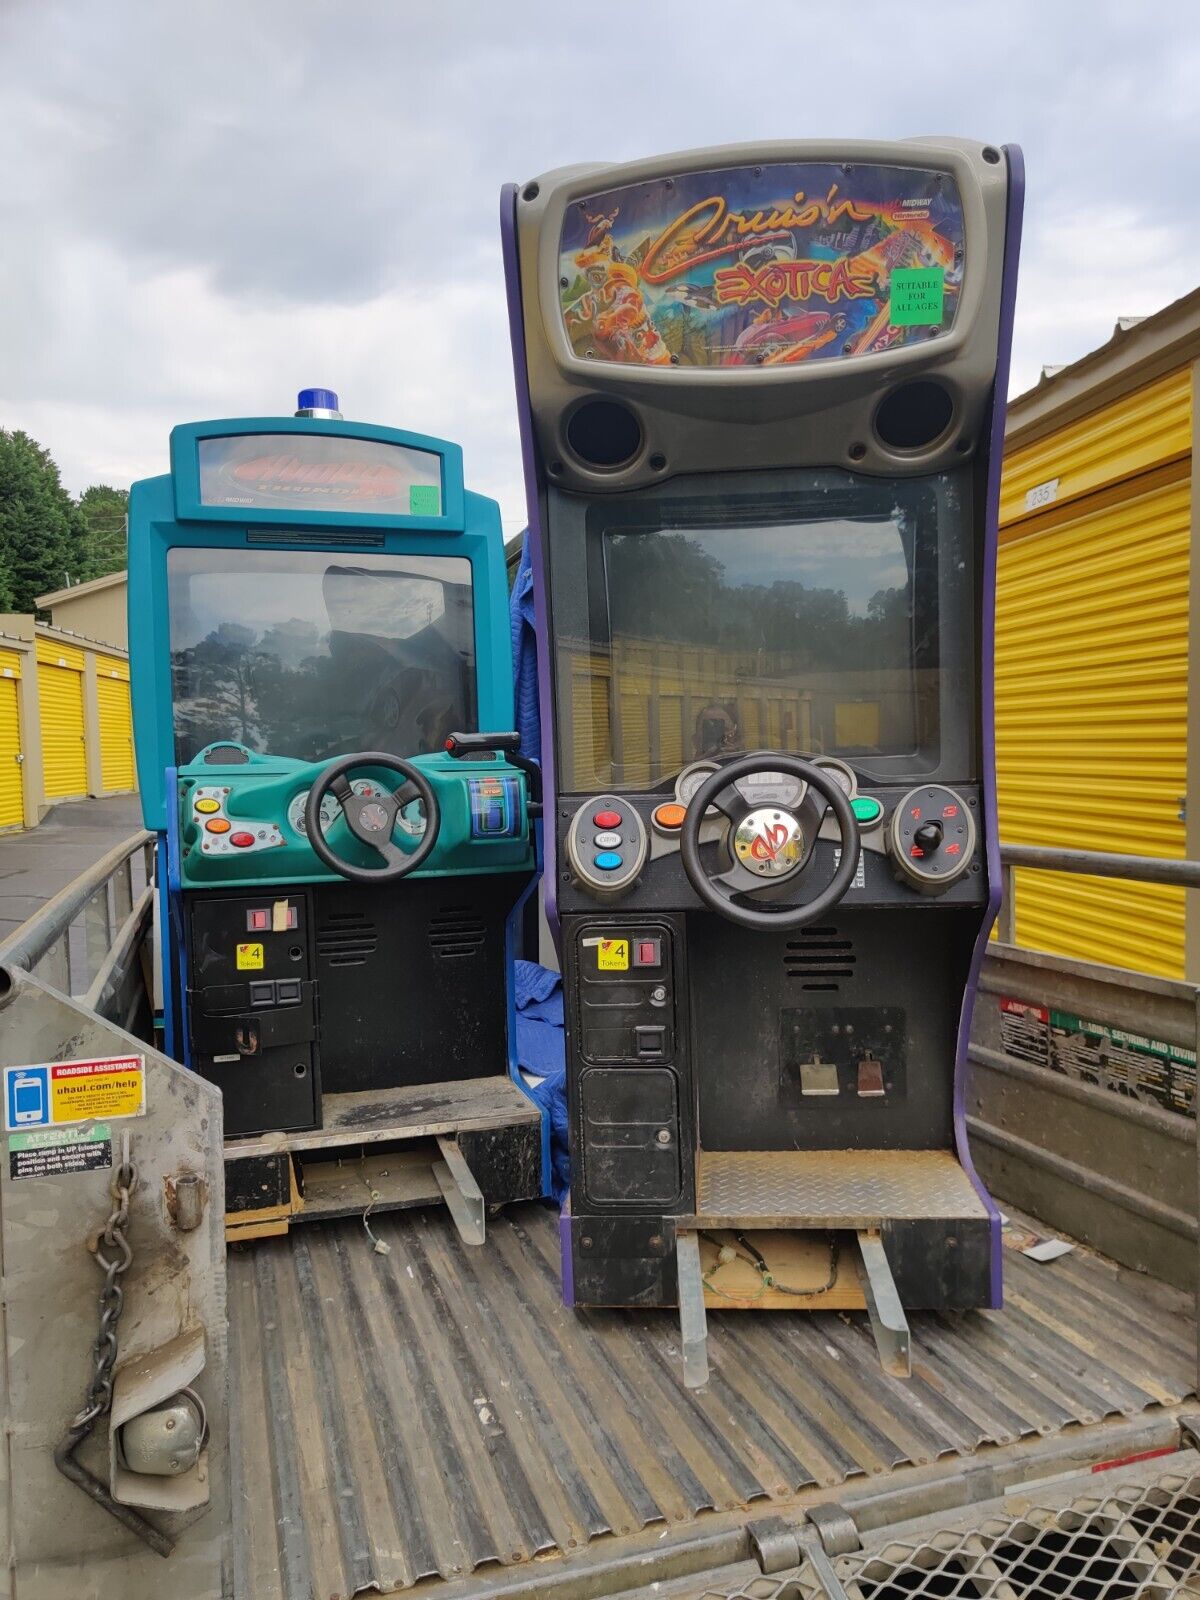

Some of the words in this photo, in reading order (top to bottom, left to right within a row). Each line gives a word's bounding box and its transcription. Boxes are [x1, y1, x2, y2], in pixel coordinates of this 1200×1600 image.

[901, 198, 932, 207] MIDWAY
[639, 184, 873, 285] Cruis'n
[715, 258, 875, 305] EXOTICA
[896, 281, 938, 290] SUITABLE
[896, 303, 913, 311] ALL
[915, 302, 938, 311] AGES
[1032, 485, 1050, 506] 235
[251, 947, 261, 960] 4
[615, 944, 625, 958] 4
[57, 1066, 92, 1076] ROADSIDE
[94, 1062, 137, 1073] ASSISTANCE
[57, 1079, 137, 1095] uhaul.com/help
[66, 1145, 77, 1153] UP
[17, 1157, 46, 1167] position
[47, 1155, 60, 1163] and
[61, 1153, 86, 1161] secure
[87, 1150, 102, 1158] with
[47, 1162, 63, 1170] both
